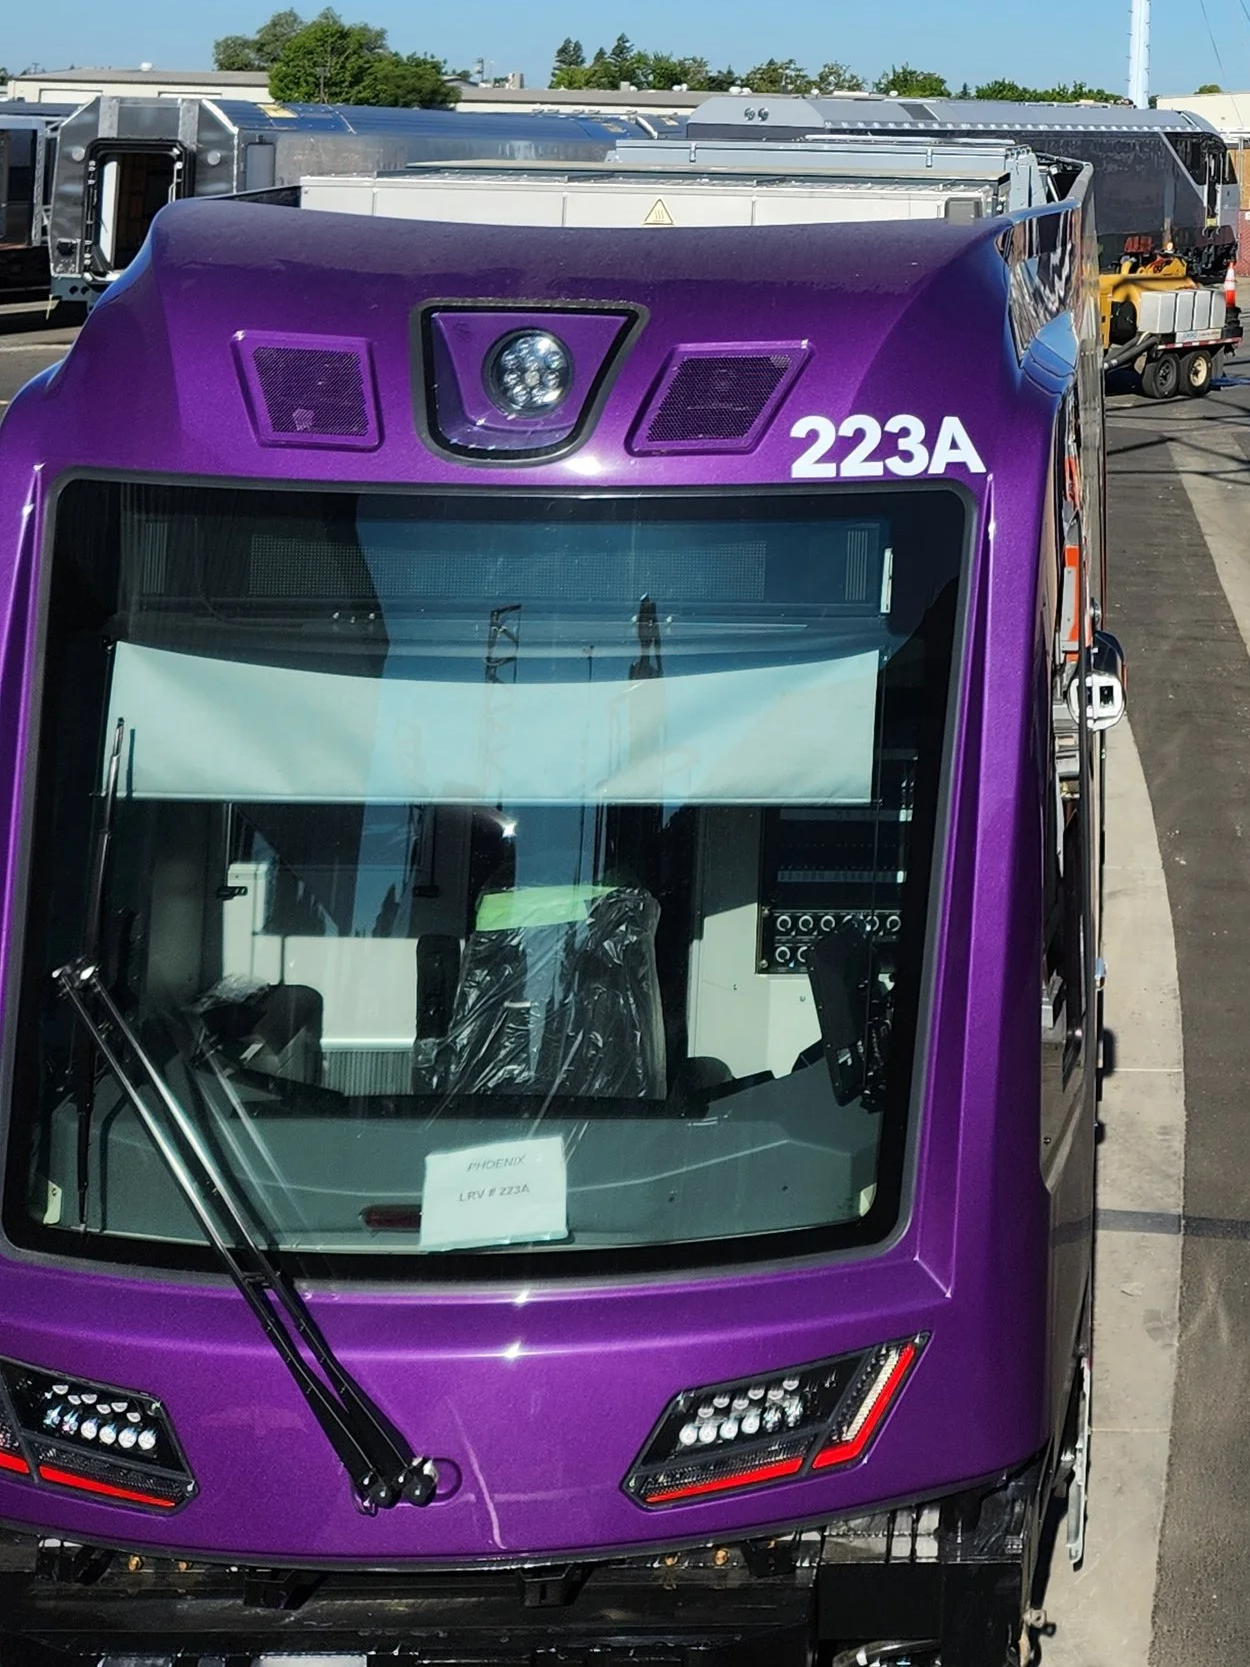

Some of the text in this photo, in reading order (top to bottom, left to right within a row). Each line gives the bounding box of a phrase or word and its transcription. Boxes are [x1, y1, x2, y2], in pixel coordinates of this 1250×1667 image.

[790, 414, 987, 478] 223A
[467, 1153, 526, 1172] PHOENIX
[459, 1183, 530, 1202] LRV # 223A
